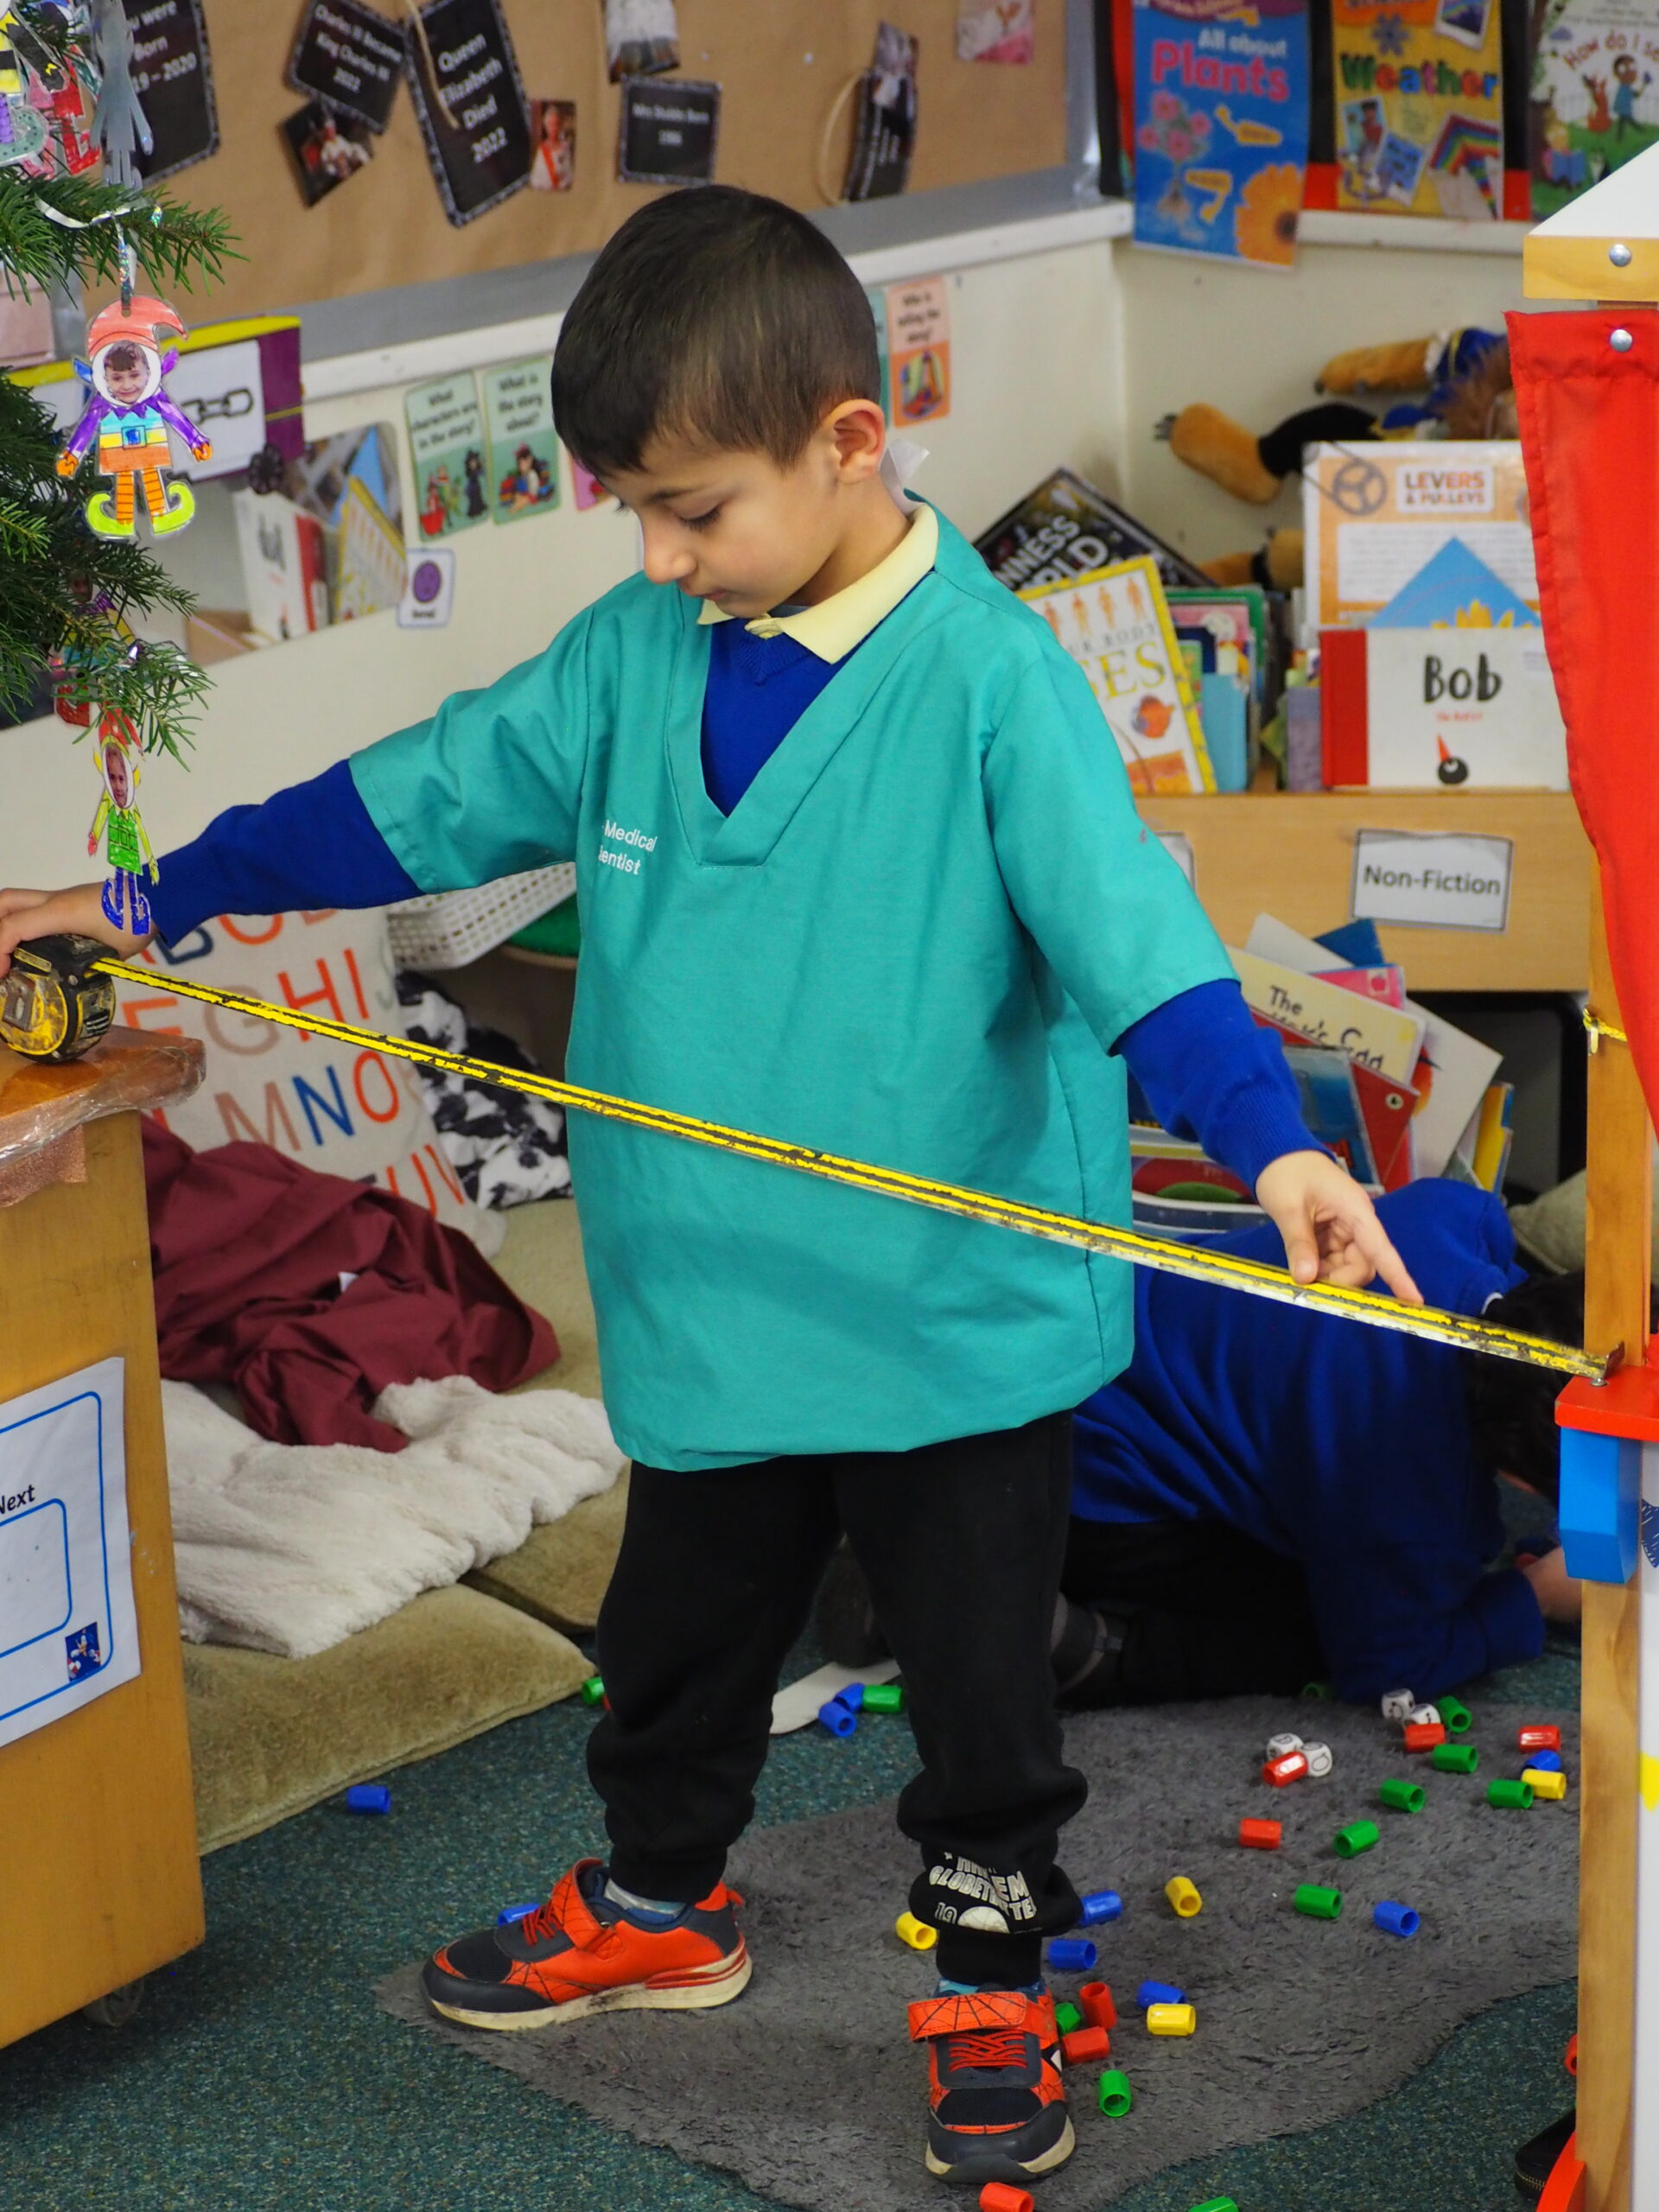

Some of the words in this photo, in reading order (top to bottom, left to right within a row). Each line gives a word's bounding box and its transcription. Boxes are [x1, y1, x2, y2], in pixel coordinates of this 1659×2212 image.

[141, 1, 177, 26] were
[134, 36, 168, 61] Born
[438, 34, 487, 73] Queen
[1198, 27, 1226, 51] All
[1229, 33, 1287, 58] about
[1562, 38, 1599, 72] How
[1605, 28, 1627, 51] do
[162, 52, 197, 81] 2020
[439, 57, 504, 107] Elizabeth
[1152, 39, 1290, 104] Plants
[1341, 53, 1497, 99] Weather
[462, 93, 499, 130] Died
[471, 127, 509, 164] 2022
[499, 375, 525, 391] What
[498, 399, 513, 413] the
[518, 394, 543, 408] story
[1405, 471, 1485, 490] LEVERS
[1421, 492, 1485, 505] PULLEYS
[994, 516, 1080, 591] NNESS
[1024, 535, 1109, 589] RLD
[1423, 652, 1503, 704] Bob
[604, 819, 658, 852] Medical
[598, 844, 641, 875] ientist
[1363, 865, 1502, 896] Non-Fiction
[1271, 984, 1303, 1015] The
